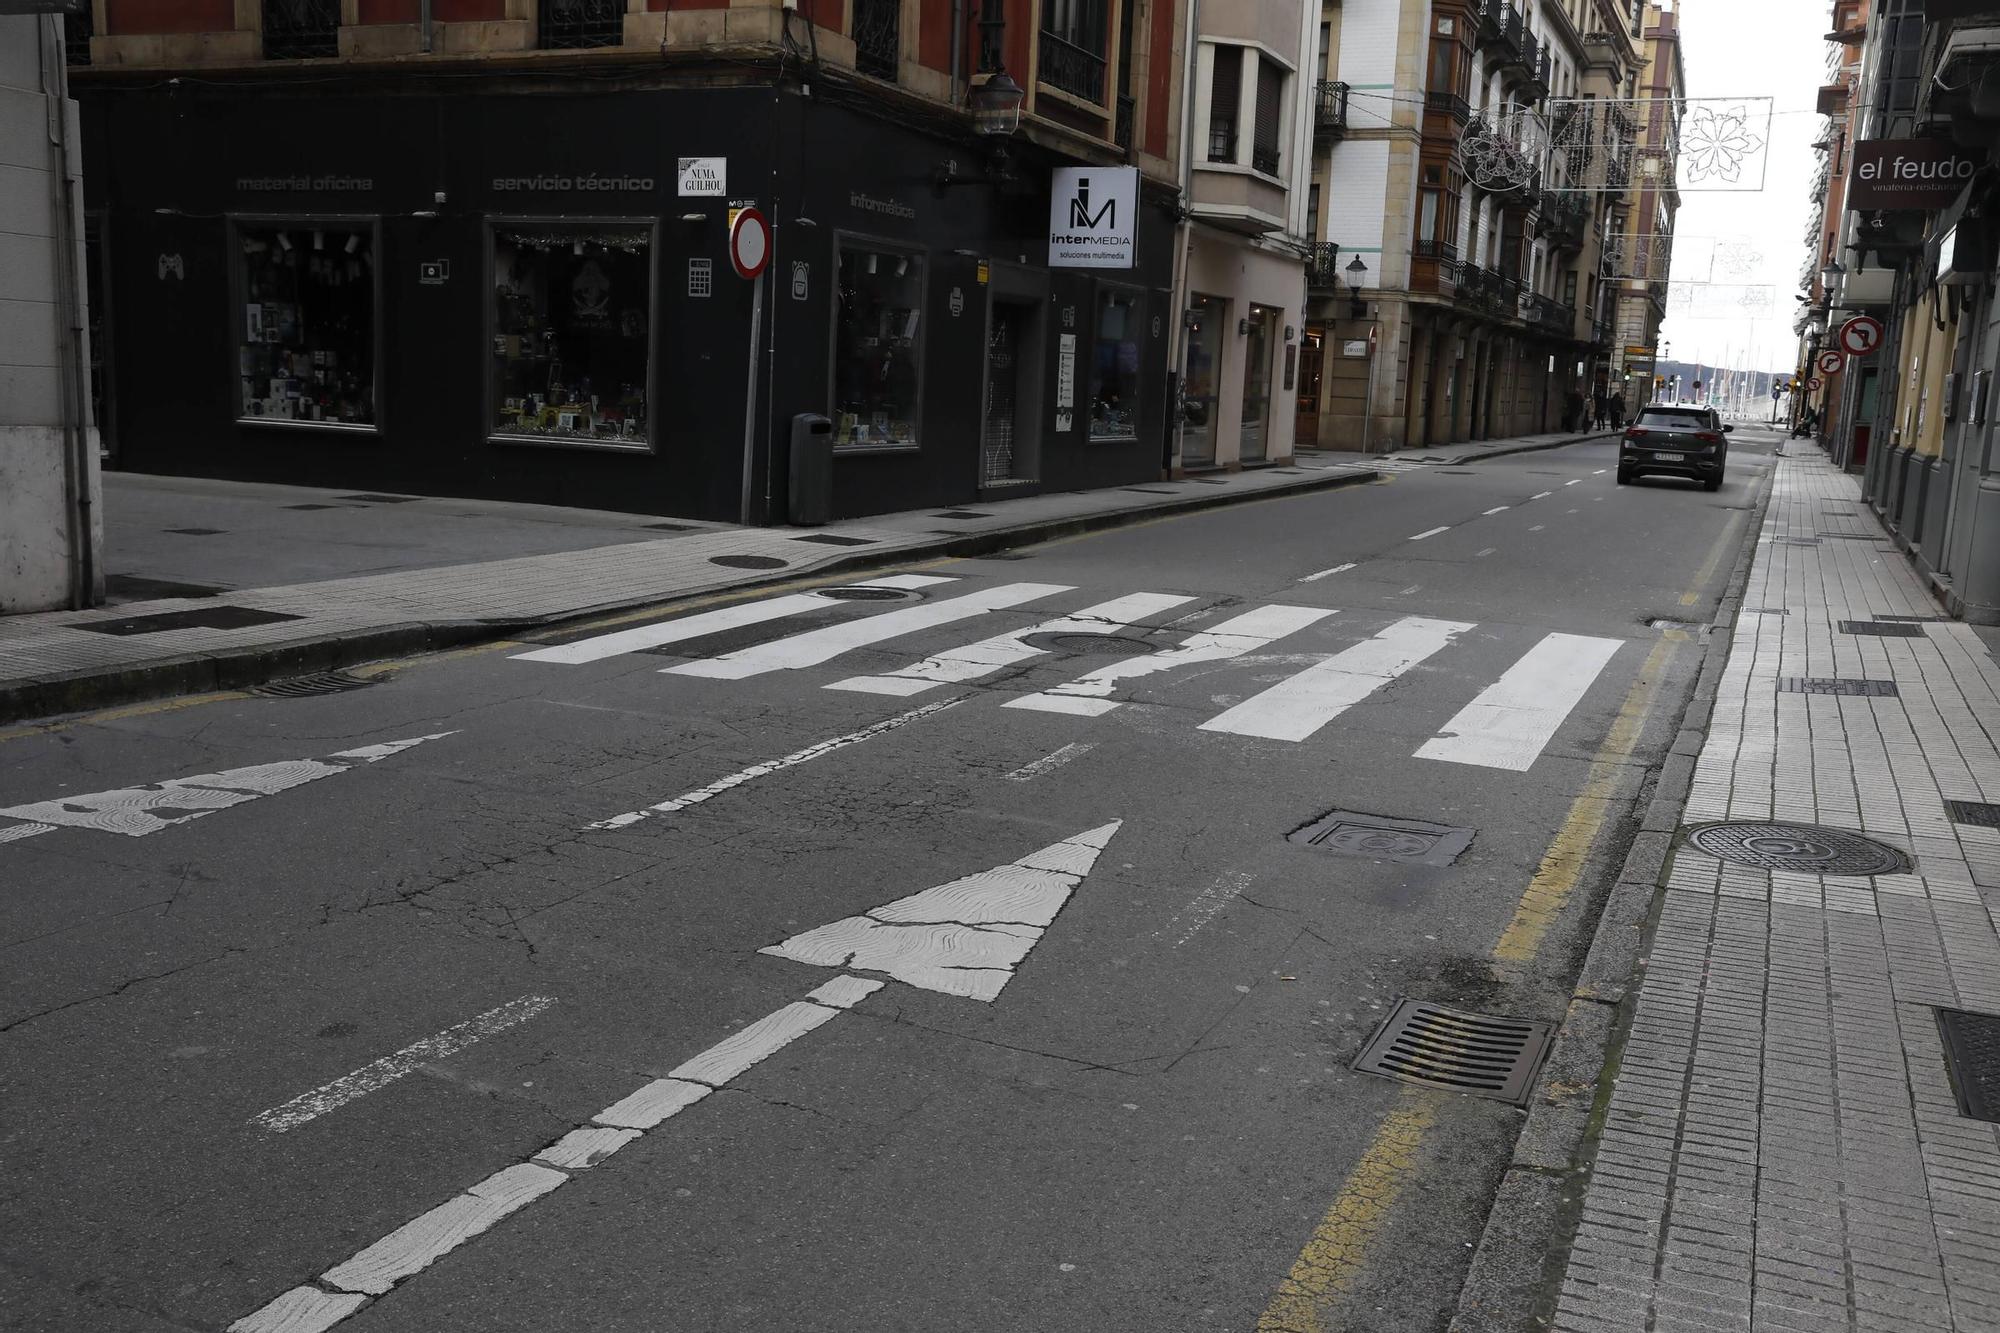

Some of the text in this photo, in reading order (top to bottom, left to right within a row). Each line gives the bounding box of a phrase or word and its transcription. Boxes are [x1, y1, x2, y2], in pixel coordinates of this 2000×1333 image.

[692, 168, 716, 179] NUMA
[1859, 154, 1974, 180] el feudo
[235, 174, 373, 191] material oficina
[491, 172, 654, 191] servicio técnico
[685, 180, 722, 191] GUILHOU
[850, 191, 915, 219] informática
[1051, 233, 1131, 245] interMEDIA
[1060, 250, 1125, 260] soluciones multimedia
